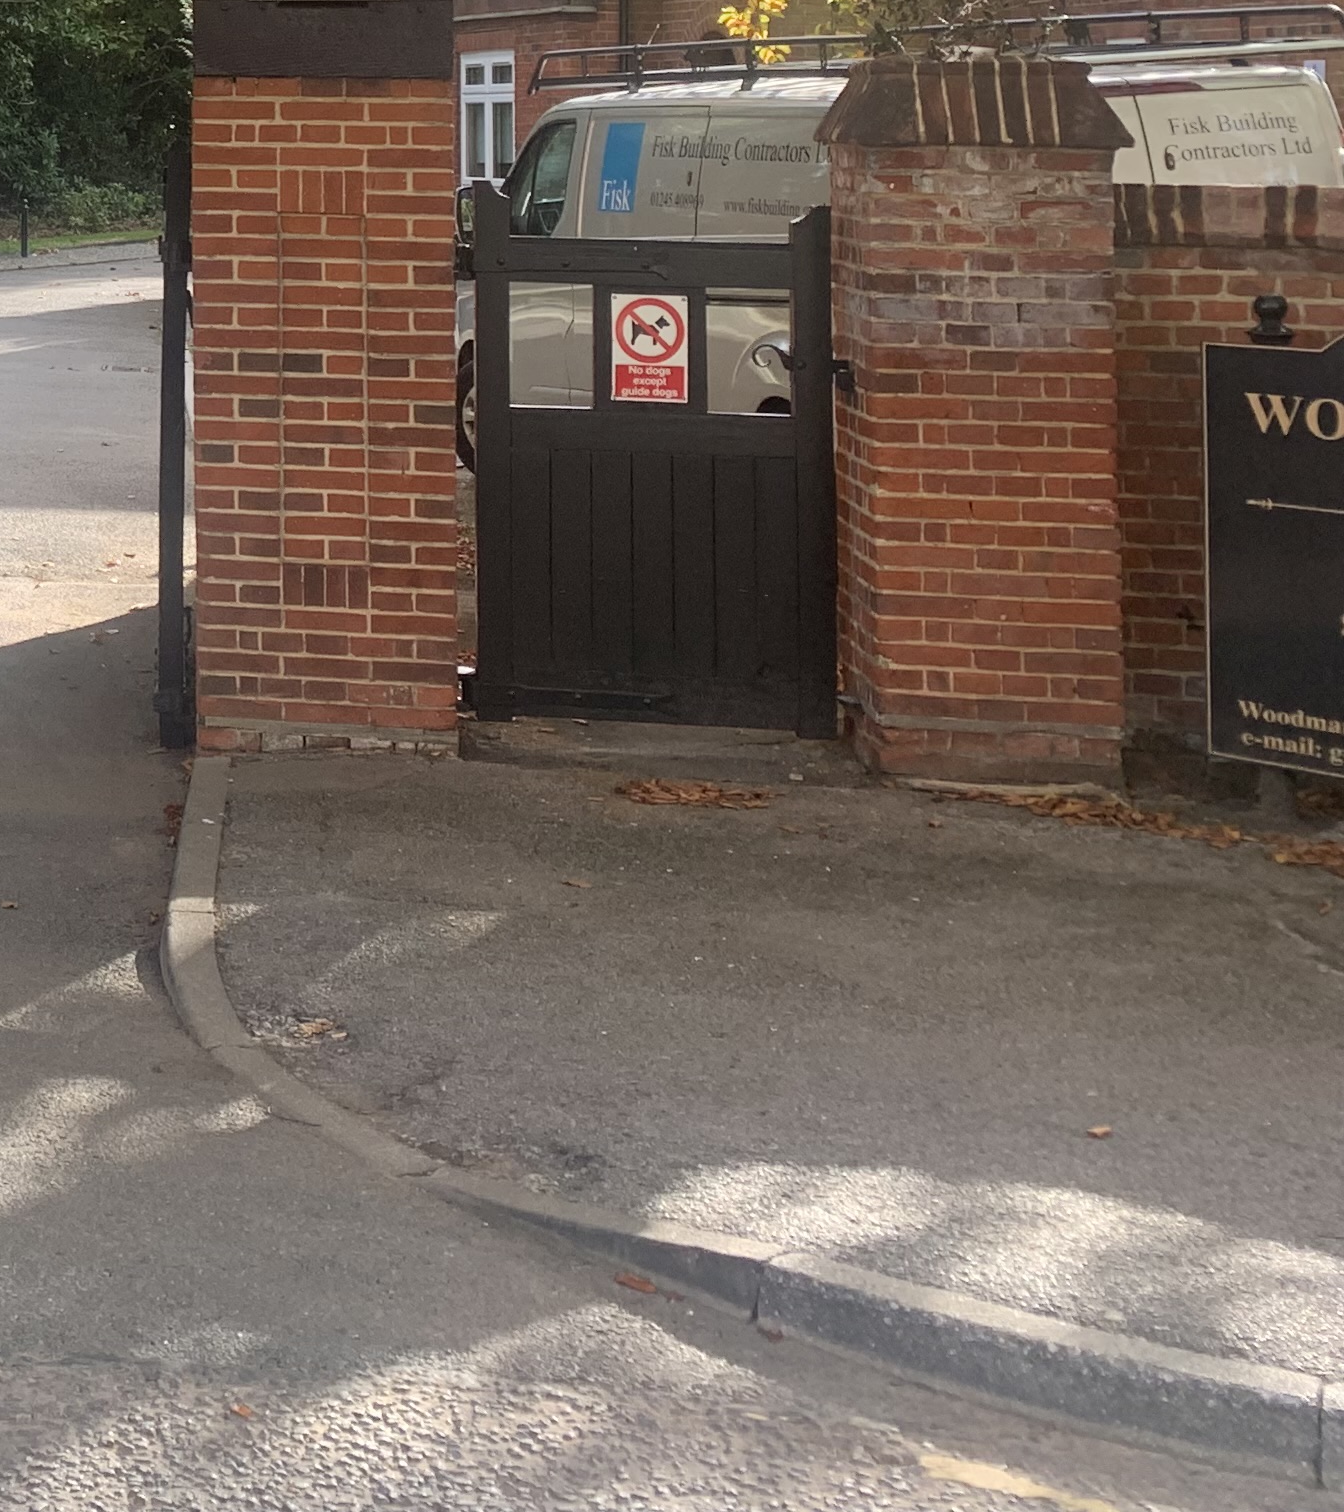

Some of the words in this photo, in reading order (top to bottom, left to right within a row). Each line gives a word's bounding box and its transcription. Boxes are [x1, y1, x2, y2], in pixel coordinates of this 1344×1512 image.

[1167, 116, 1211, 135] Fisk
[1216, 112, 1299, 133] Building
[652, 135, 676, 158] Fisk
[678, 135, 732, 166] Building
[734, 137, 811, 164] Contractors
[1164, 141, 1277, 163] Contractors
[1281, 136, 1313, 155] Ltd
[601, 179, 631, 211] Fisk
[628, 366, 644, 375] No
[645, 366, 671, 376] dogs
[632, 376, 667, 387] except
[621, 386, 650, 397] guide
[652, 387, 678, 399] dogs
[1244, 392, 1344, 441] WO
[1238, 698, 1344, 735] Woodma
[1240, 732, 1323, 759] e-mail:
